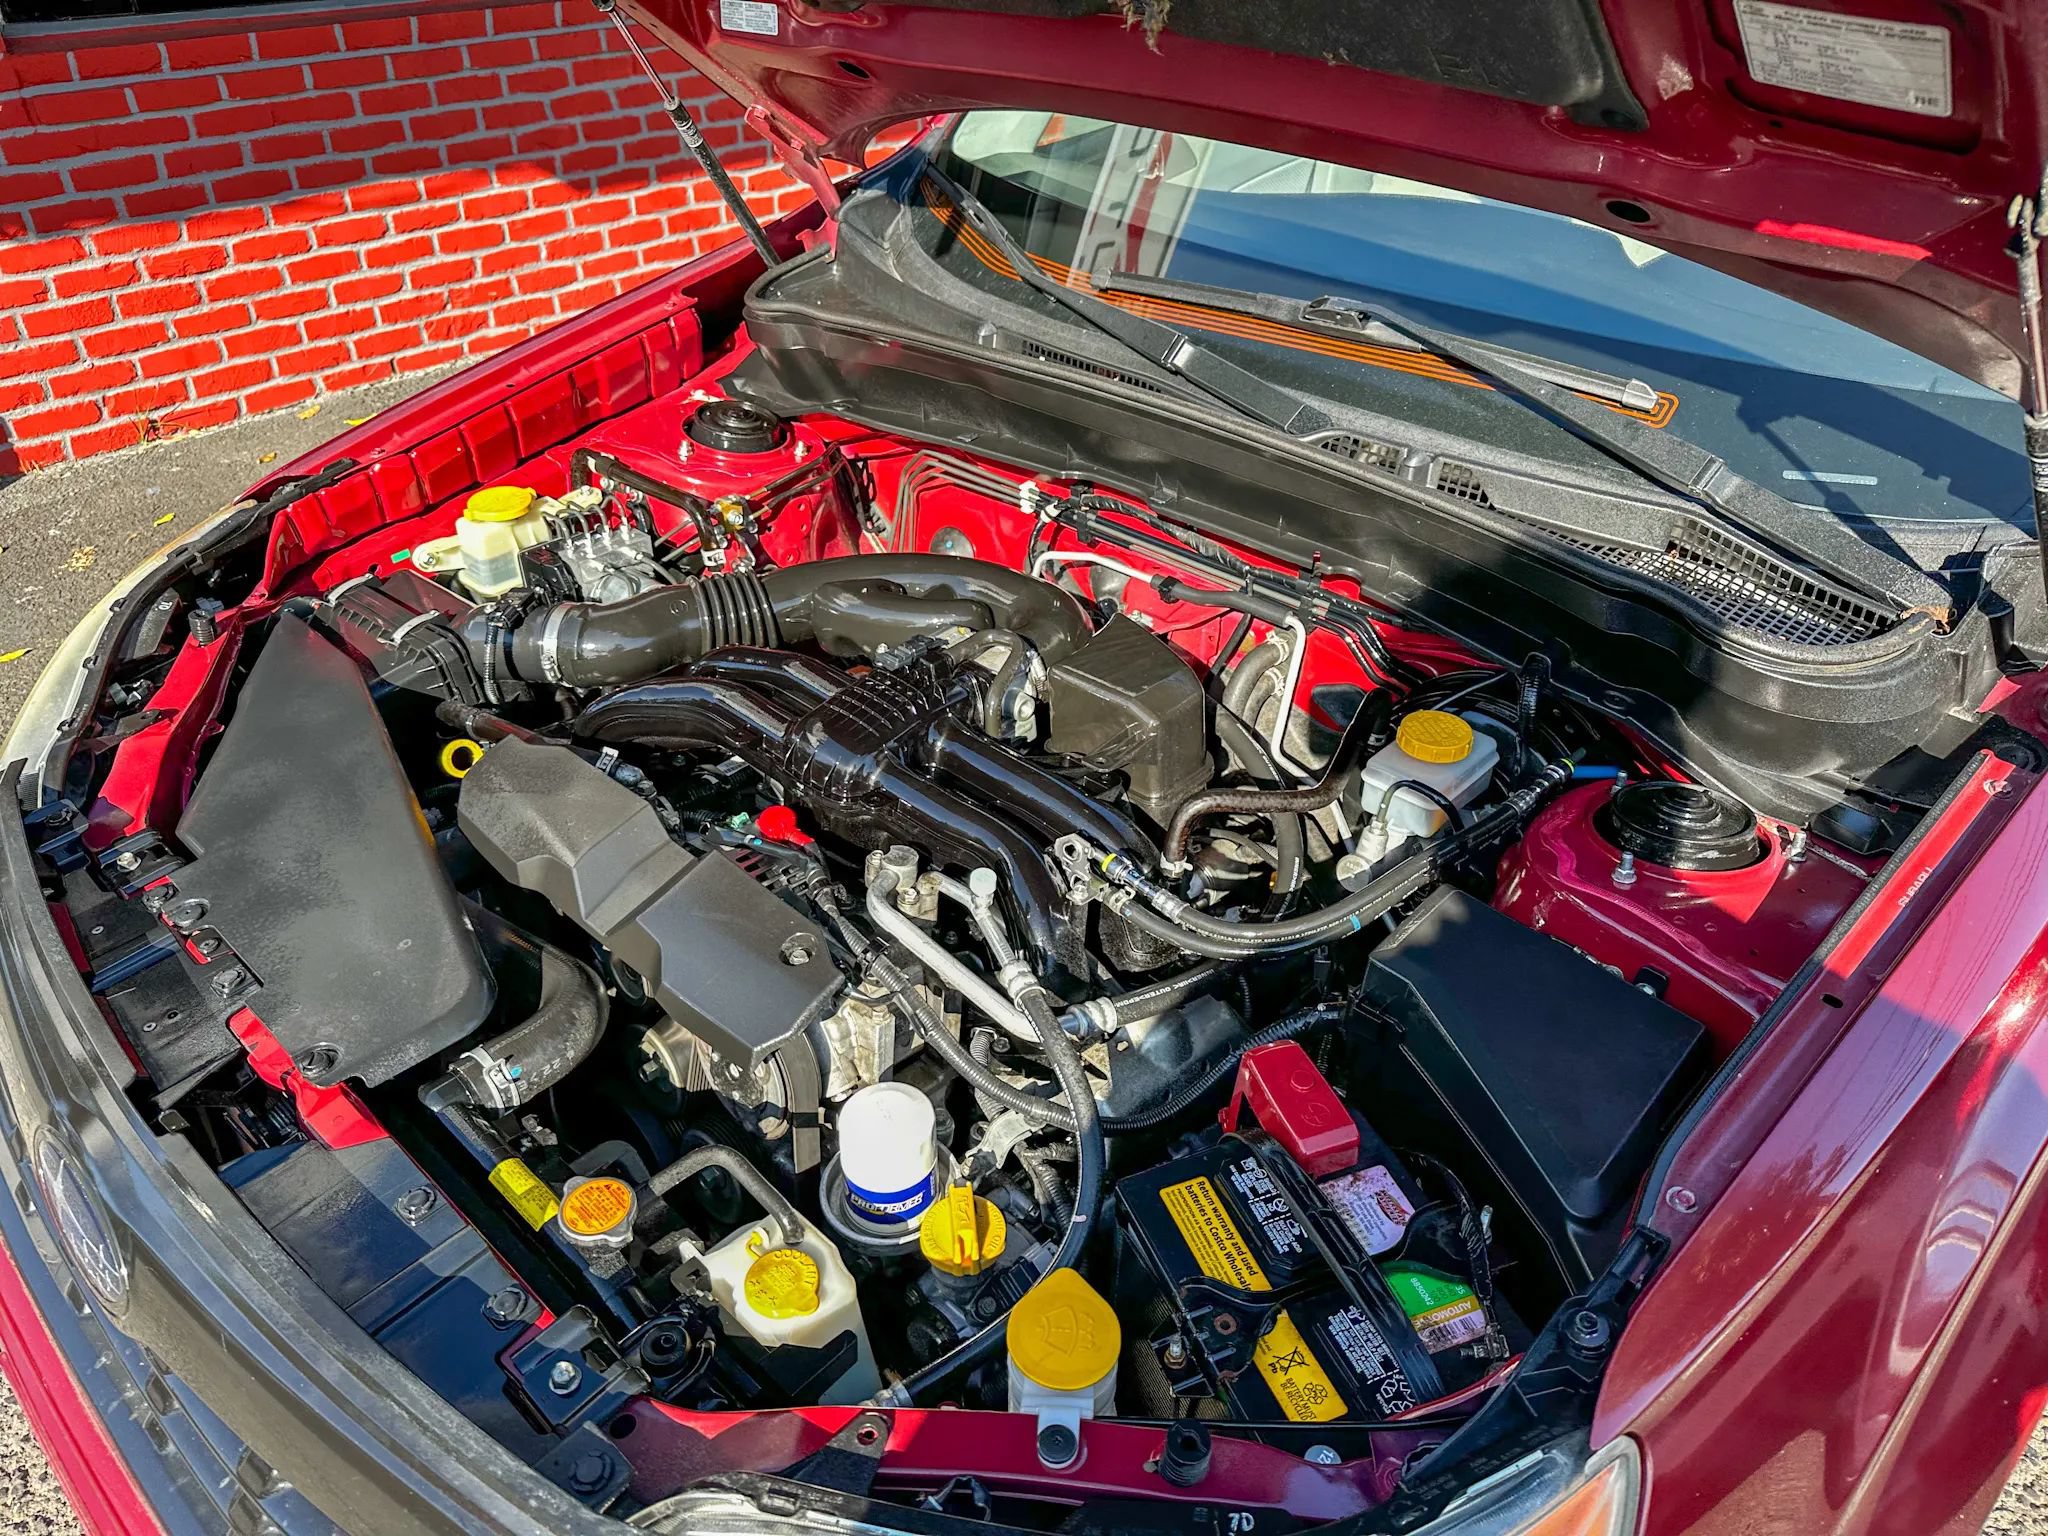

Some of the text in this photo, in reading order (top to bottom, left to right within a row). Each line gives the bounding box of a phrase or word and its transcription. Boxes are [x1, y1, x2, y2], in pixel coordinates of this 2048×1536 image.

[1184, 1184, 1208, 1216] batteries
[1203, 1217, 1212, 1226] to
[1208, 1226, 1227, 1251] Costco
[1196, 1180, 1258, 1276] Return warranty and used
[1454, 1284, 1466, 1294] 35
[1267, 1361, 1279, 1373] Pb
[1280, 1382, 1308, 1421] BE RECYCLED
[1286, 1377, 1316, 1420] BATTERY MUST
